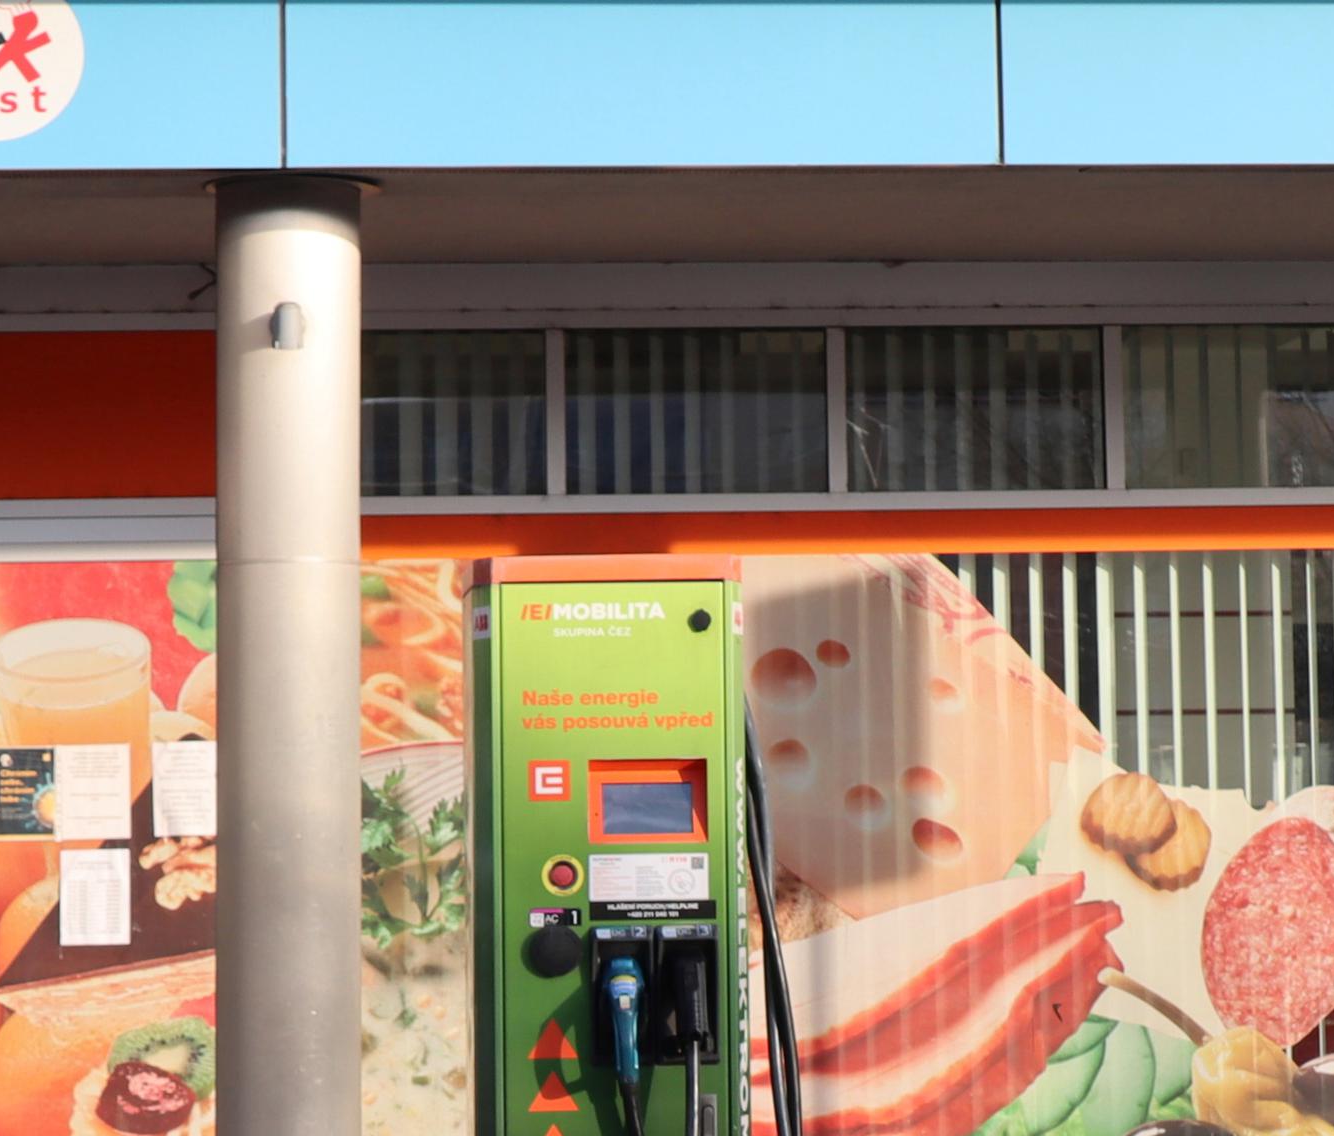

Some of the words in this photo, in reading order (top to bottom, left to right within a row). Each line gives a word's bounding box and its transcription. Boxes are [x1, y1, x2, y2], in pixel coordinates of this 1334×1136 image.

[553, 627, 605, 638] SKUPINA
[607, 624, 632, 637] ČEZ
[522, 690, 574, 707] Naše
[579, 690, 659, 709] energie
[522, 712, 557, 731] vás
[562, 712, 649, 732] posouvá
[654, 711, 713, 731] vpřed
[545, 914, 559, 925] AC
[571, 910, 578, 925] 1
[635, 926, 647, 938] 2
[699, 925, 710, 938] 3
